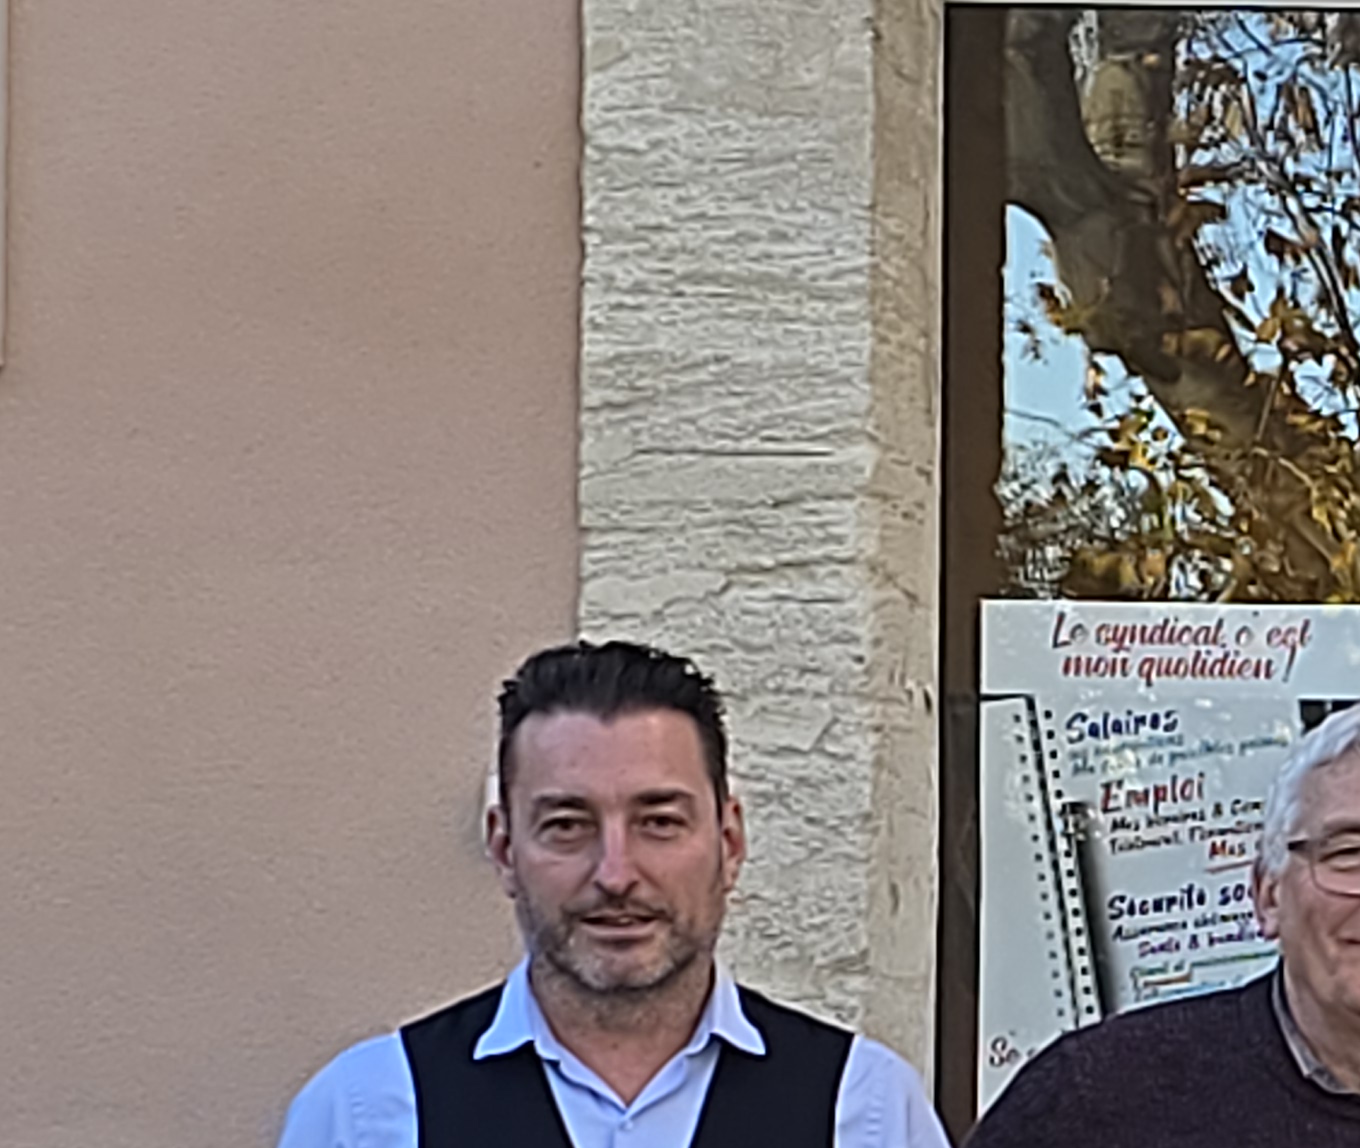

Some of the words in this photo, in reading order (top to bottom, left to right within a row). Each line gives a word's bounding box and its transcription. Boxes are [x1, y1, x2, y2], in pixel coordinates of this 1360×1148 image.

[1053, 611, 1088, 649] Le
[1096, 616, 1226, 652] syndicat
[1062, 655, 1131, 678] mon
[1138, 650, 1276, 687] quotidien
[1066, 709, 1179, 744] Salaires
[1101, 772, 1205, 815] Emploi
